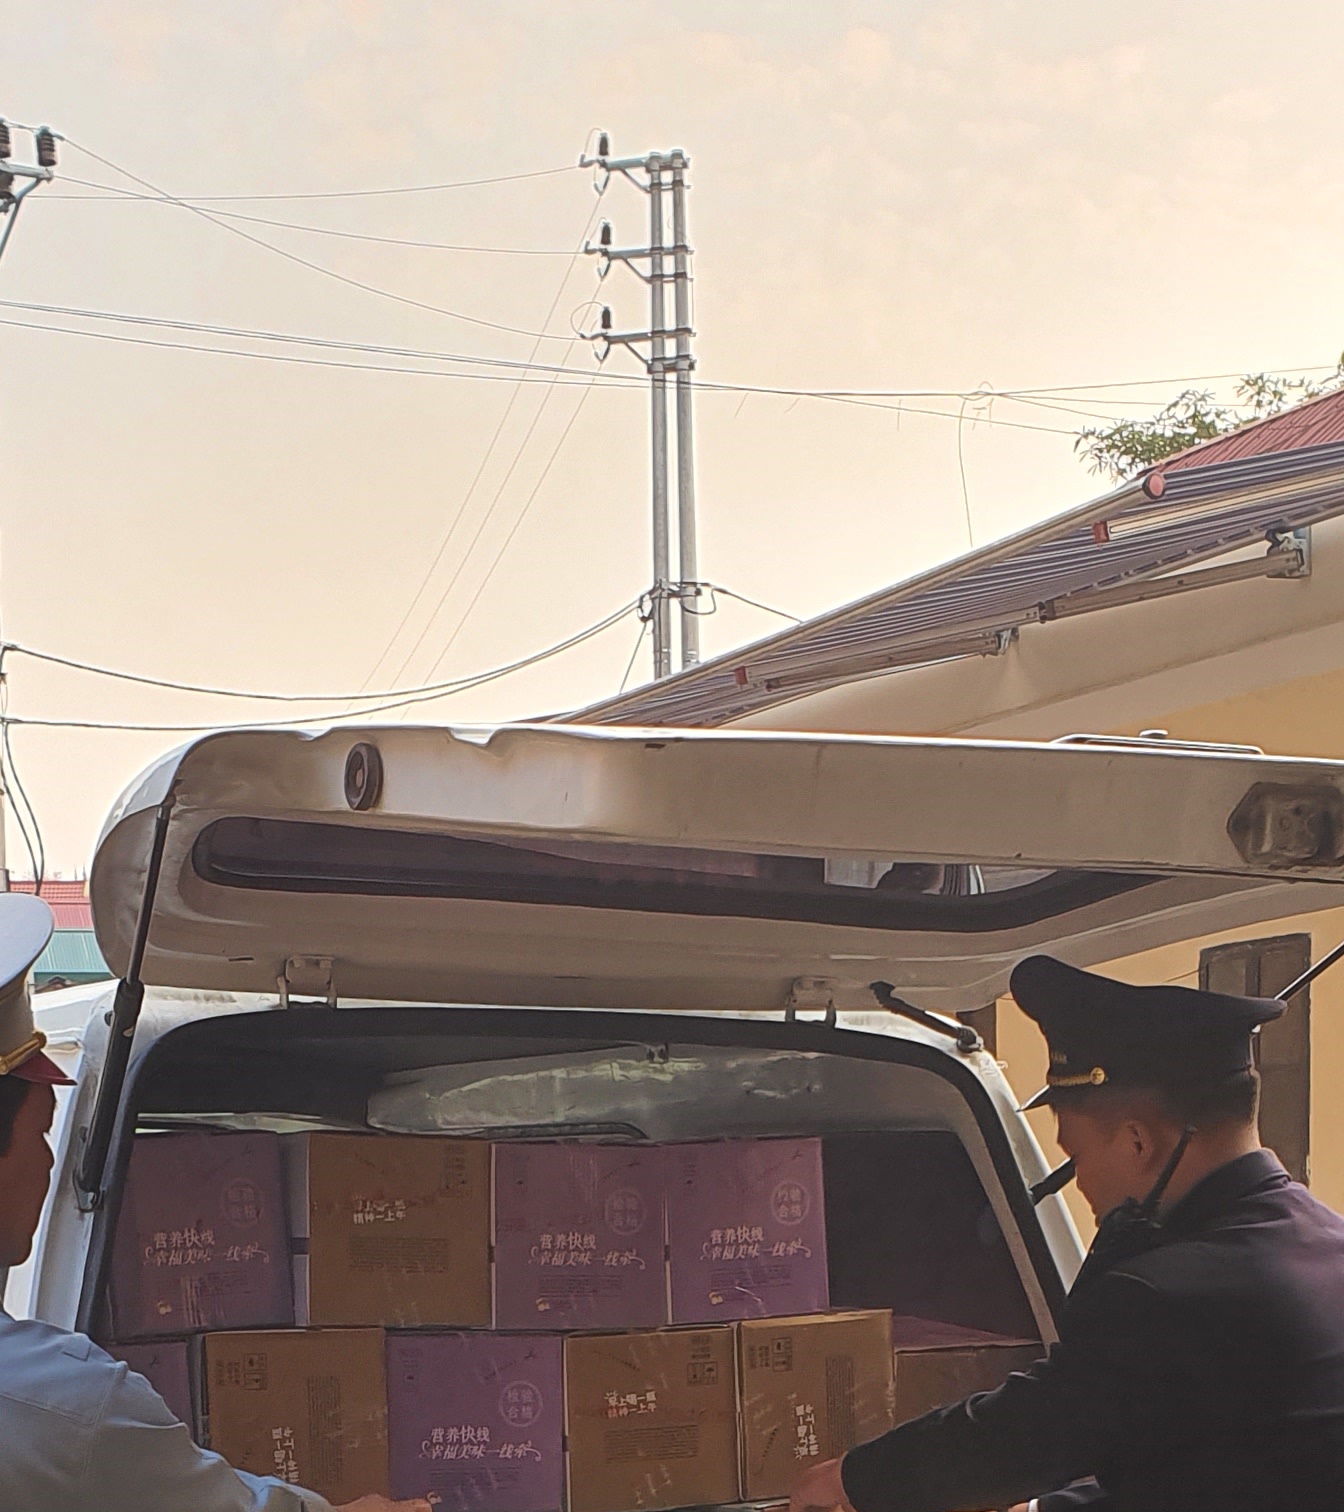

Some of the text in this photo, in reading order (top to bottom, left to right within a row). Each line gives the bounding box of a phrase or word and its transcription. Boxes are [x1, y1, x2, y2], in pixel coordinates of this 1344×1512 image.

[540, 1232, 596, 1251] 营养快线
[711, 1226, 763, 1244] 营养快线
[431, 1425, 490, 1443] 营养快线
